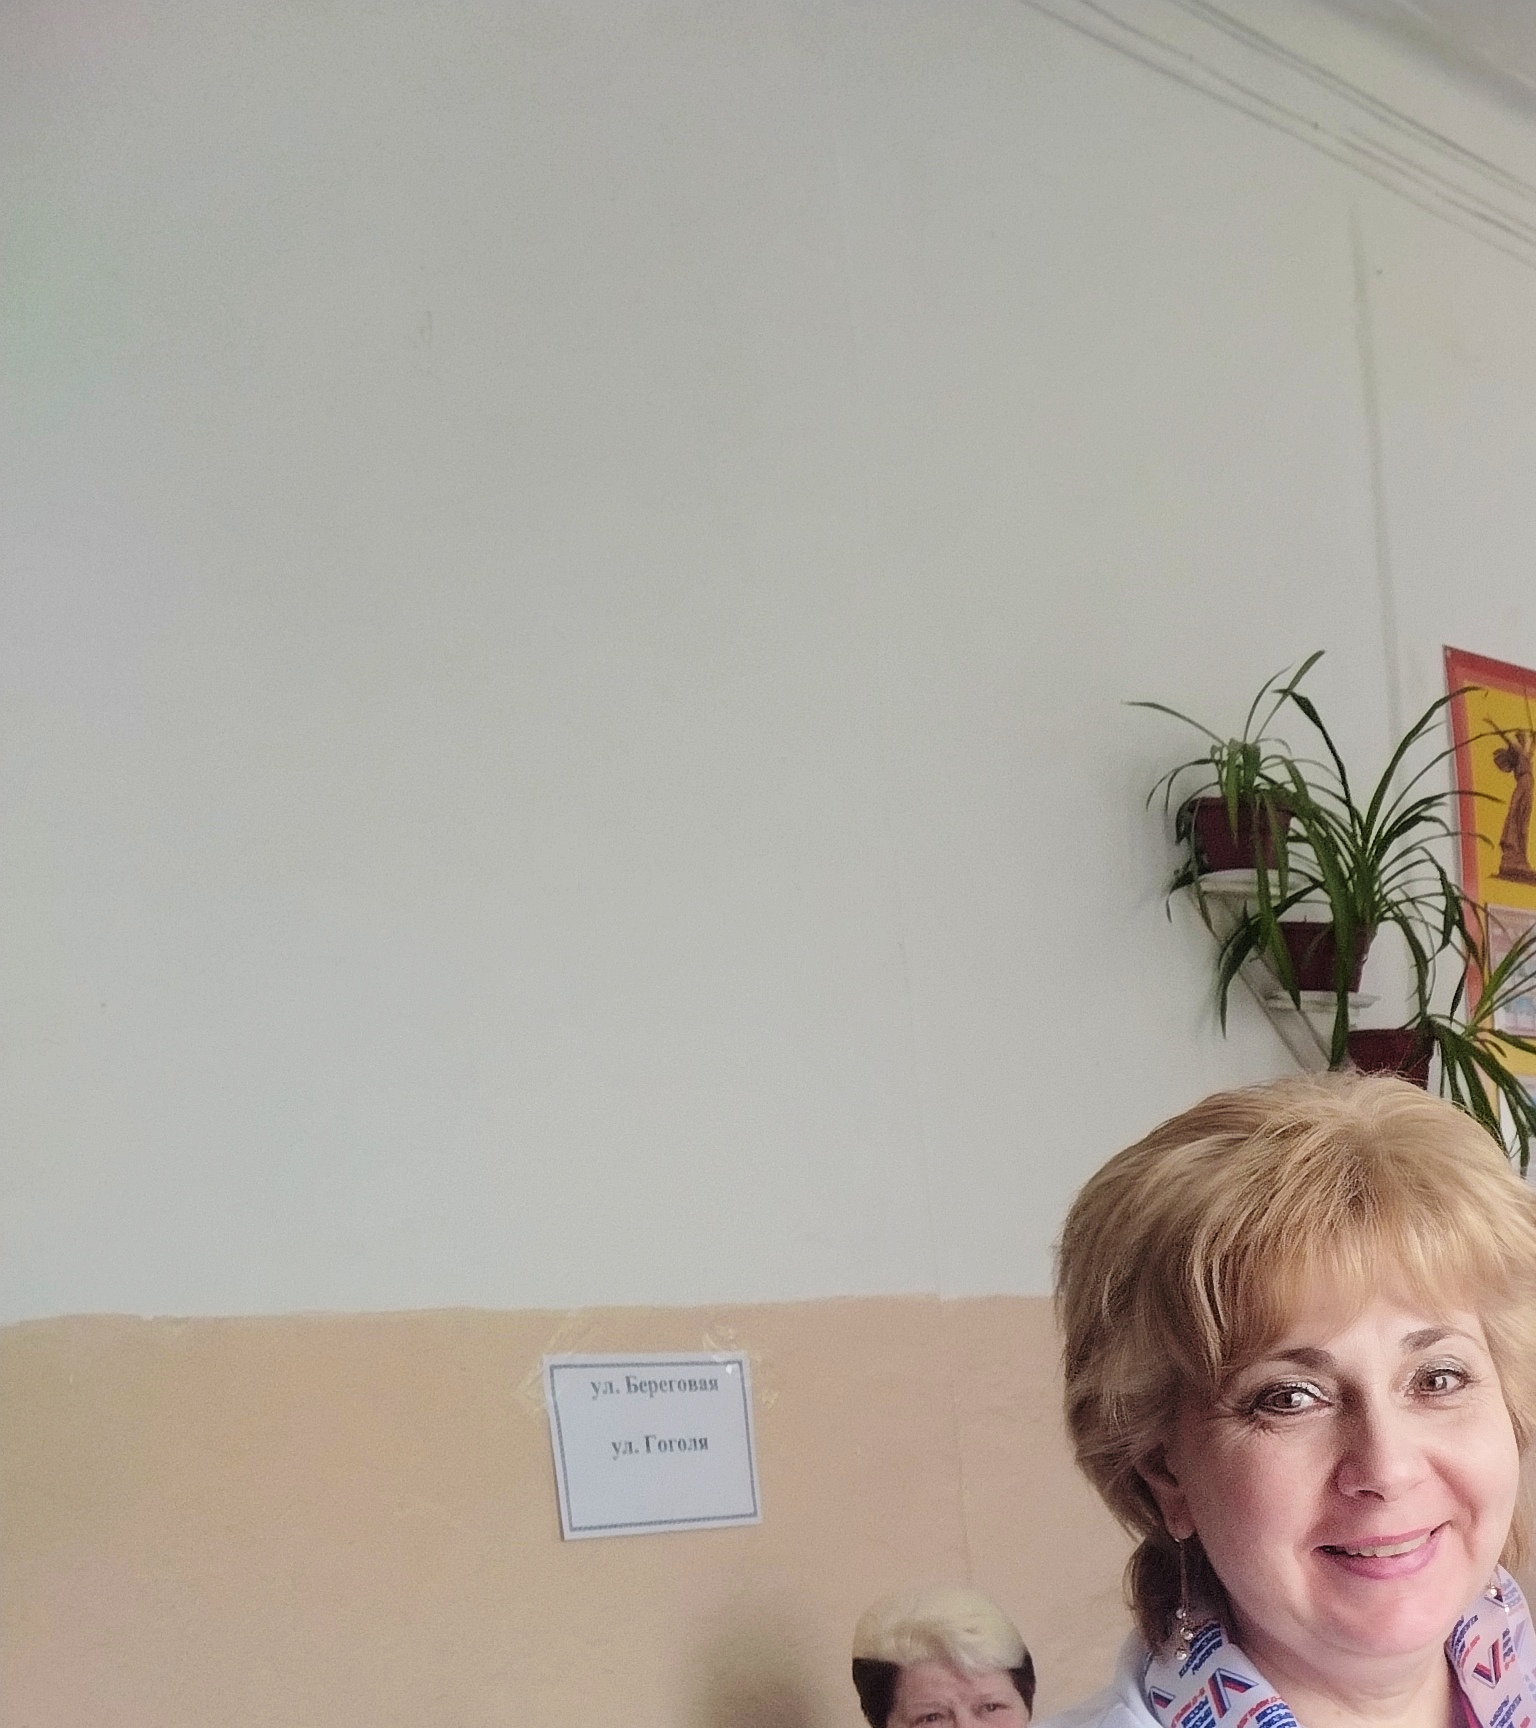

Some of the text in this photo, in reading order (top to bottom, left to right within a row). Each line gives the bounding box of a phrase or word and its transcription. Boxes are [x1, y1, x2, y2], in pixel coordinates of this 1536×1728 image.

[590, 1375, 719, 1400] ул. Береговая
[611, 1435, 709, 1460] ул. Гоголя
